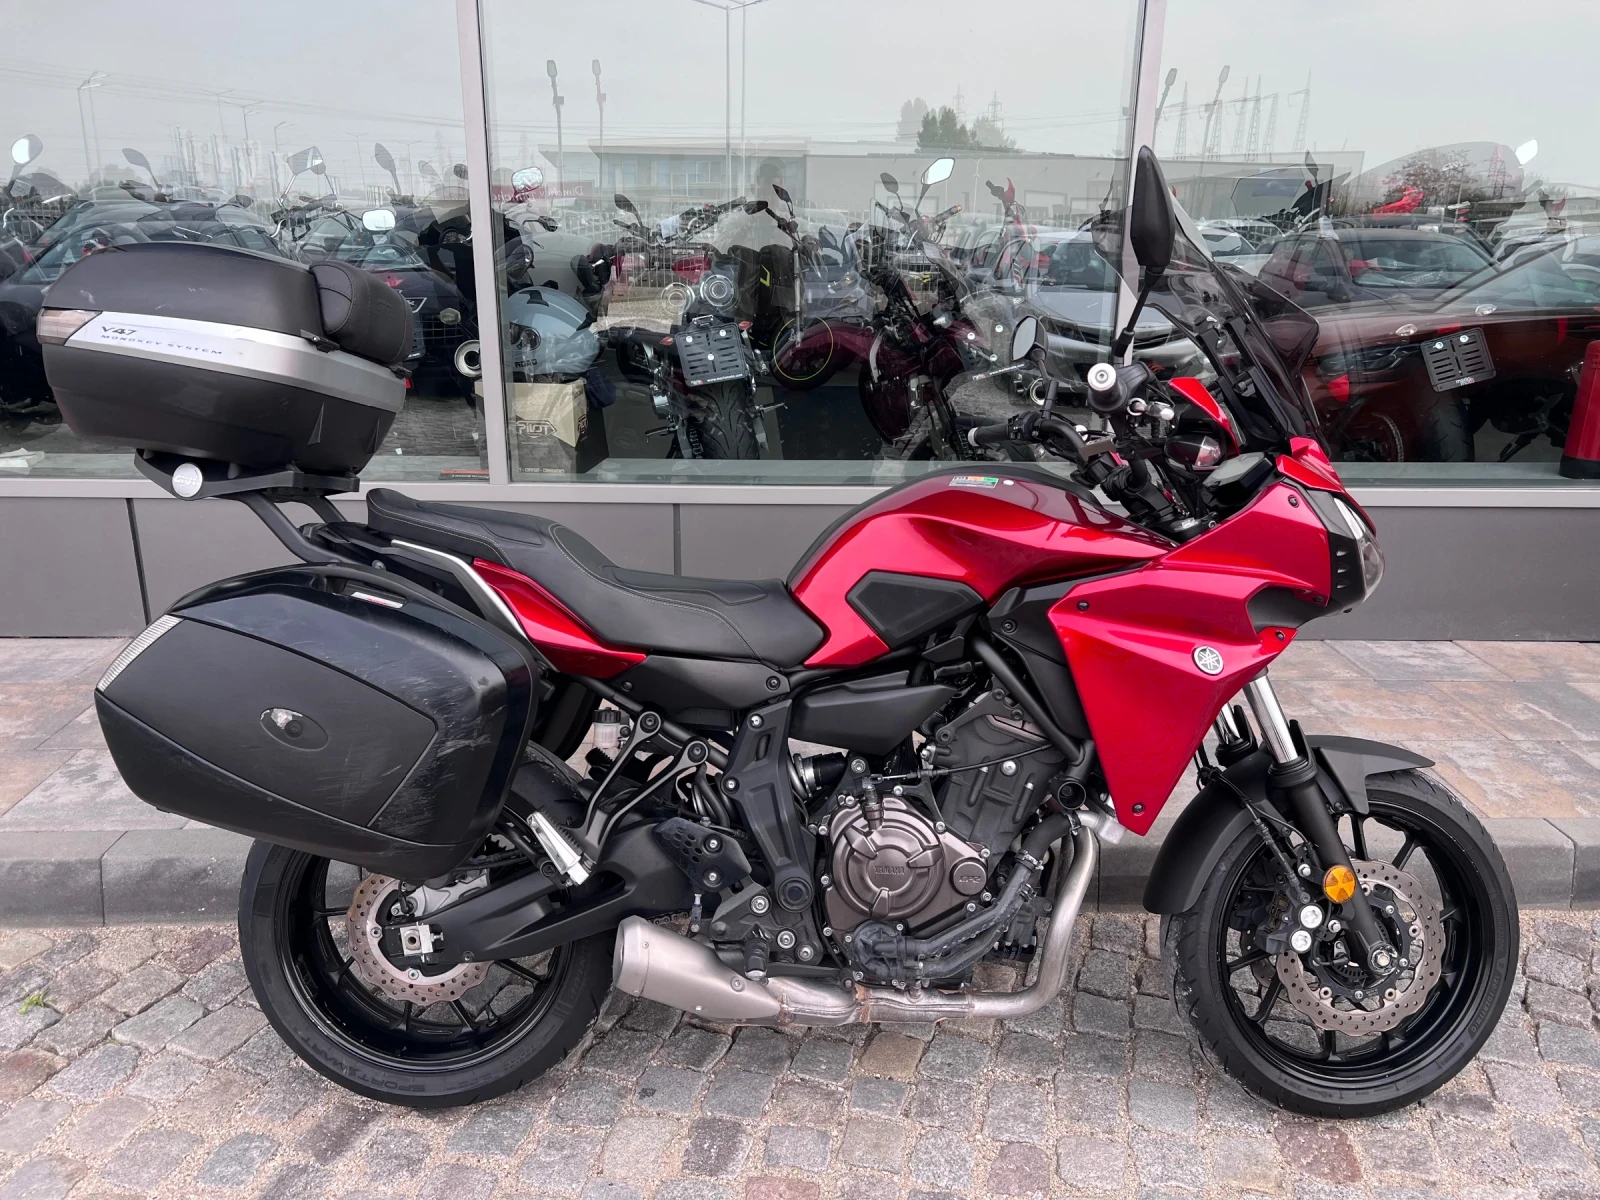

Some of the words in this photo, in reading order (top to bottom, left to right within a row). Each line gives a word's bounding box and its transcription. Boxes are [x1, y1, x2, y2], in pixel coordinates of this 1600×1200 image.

[100, 334, 162, 345] MONOKEY
[167, 343, 223, 355] SYSTEM
[516, 423, 551, 436] PILOT
[874, 865, 905, 876] YAMAHA
